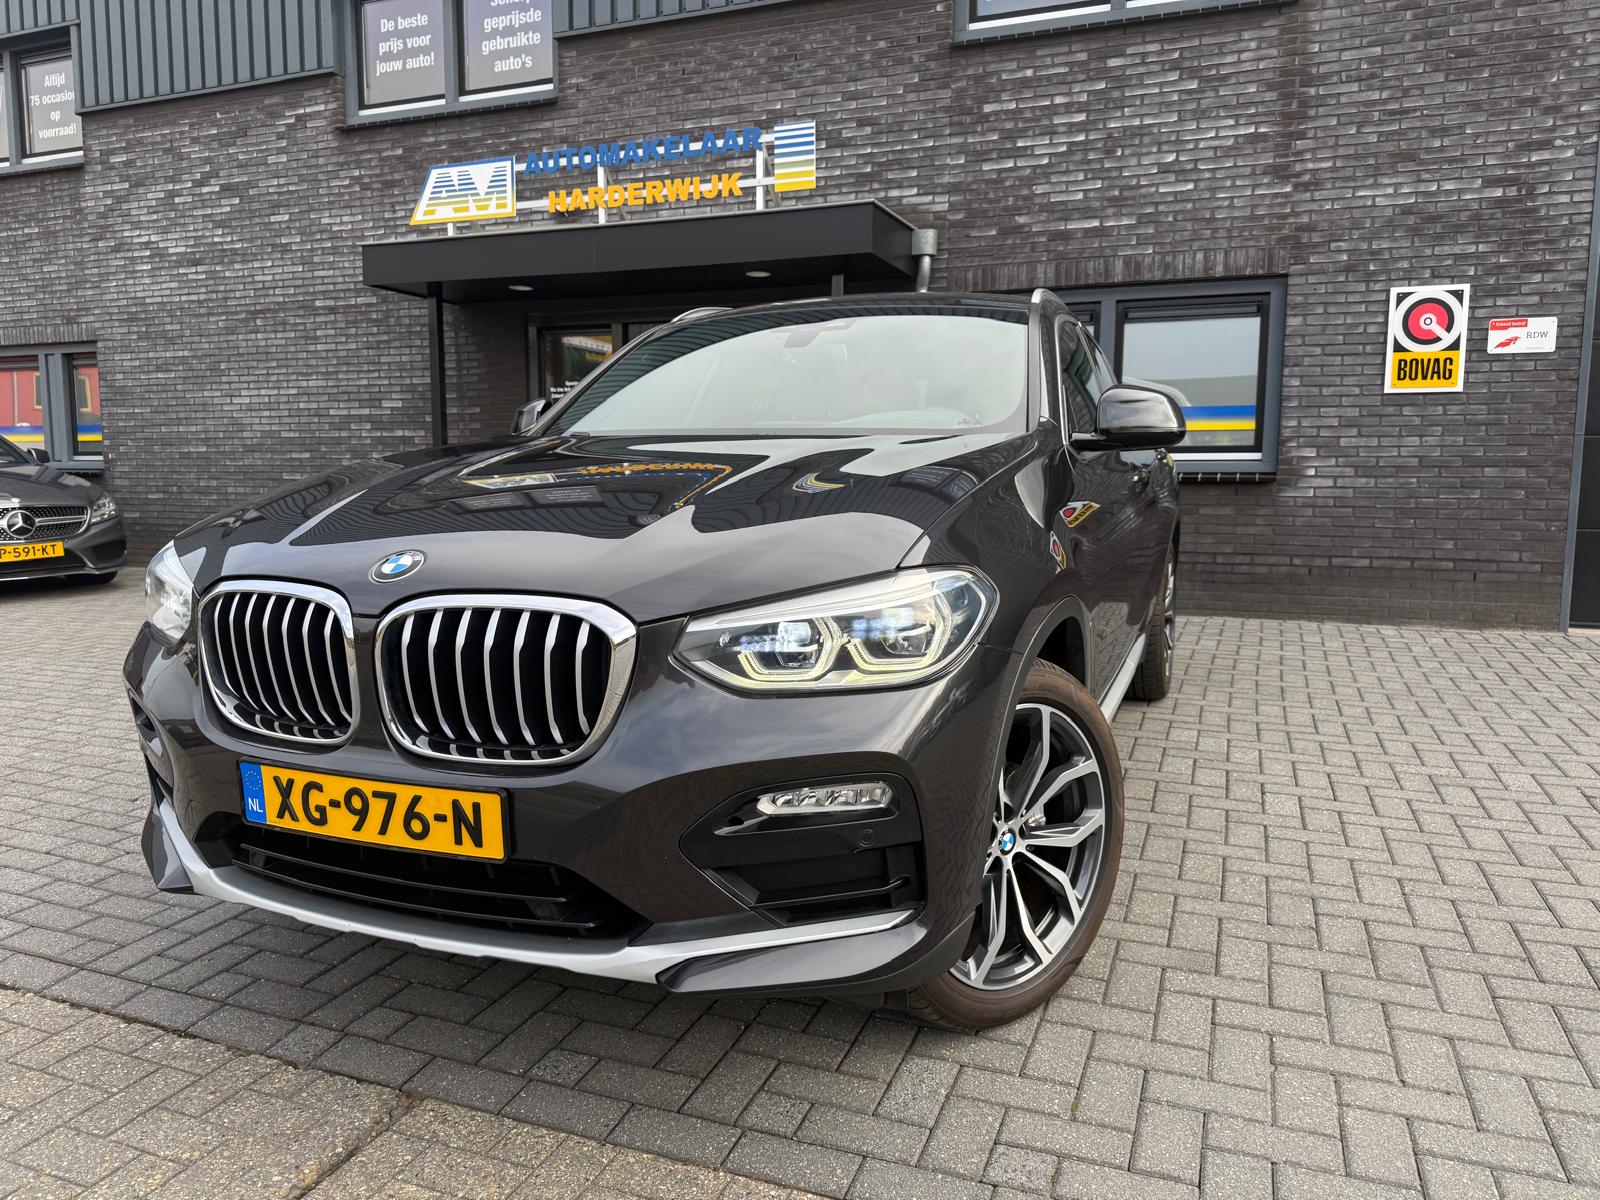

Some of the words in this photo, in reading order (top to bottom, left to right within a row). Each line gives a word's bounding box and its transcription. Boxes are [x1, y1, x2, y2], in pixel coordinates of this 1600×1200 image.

[380, 18, 395, 33] De
[398, 13, 428, 30] beste
[484, 9, 542, 33] geprijsde
[379, 38, 403, 55] prijs
[406, 33, 432, 48] voor
[482, 31, 541, 55] gebruikte
[376, 57, 403, 77] jouw
[406, 52, 435, 69] auto!
[494, 53, 533, 73] auto's
[44, 72, 66, 88] Altijd
[30, 94, 40, 107] 75
[50, 110, 61, 122] op
[38, 122, 77, 139] voorraad!
[524, 126, 764, 177] AUTOMAKELAAR
[548, 171, 743, 214] HARDERWIJK
[1526, 331, 1549, 339] RDW
[1397, 357, 1454, 381] BOVAG
[248, 797, 264, 813] NL
[272, 775, 483, 848] XG-976-N
